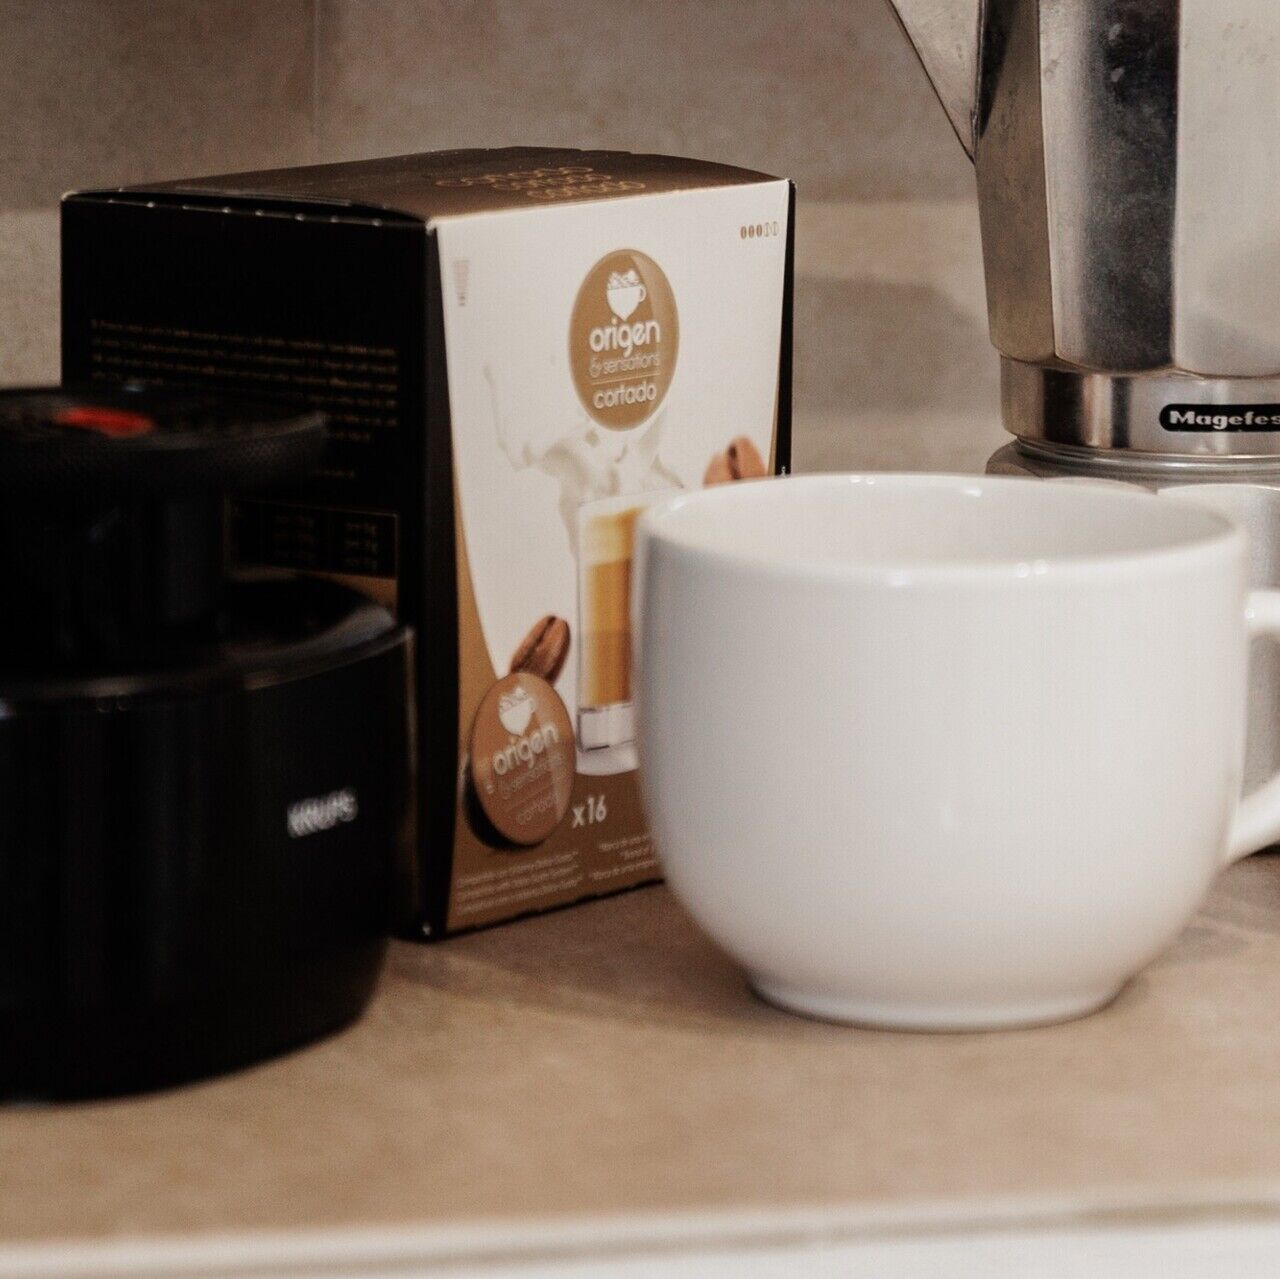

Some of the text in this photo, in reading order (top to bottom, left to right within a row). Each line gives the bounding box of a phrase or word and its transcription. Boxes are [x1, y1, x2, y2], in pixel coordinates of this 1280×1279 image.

[589, 317, 660, 358] origen
[603, 352, 660, 371] sensations
[593, 380, 657, 409] cortado
[493, 724, 559, 776] origen
[572, 795, 608, 829] x16
